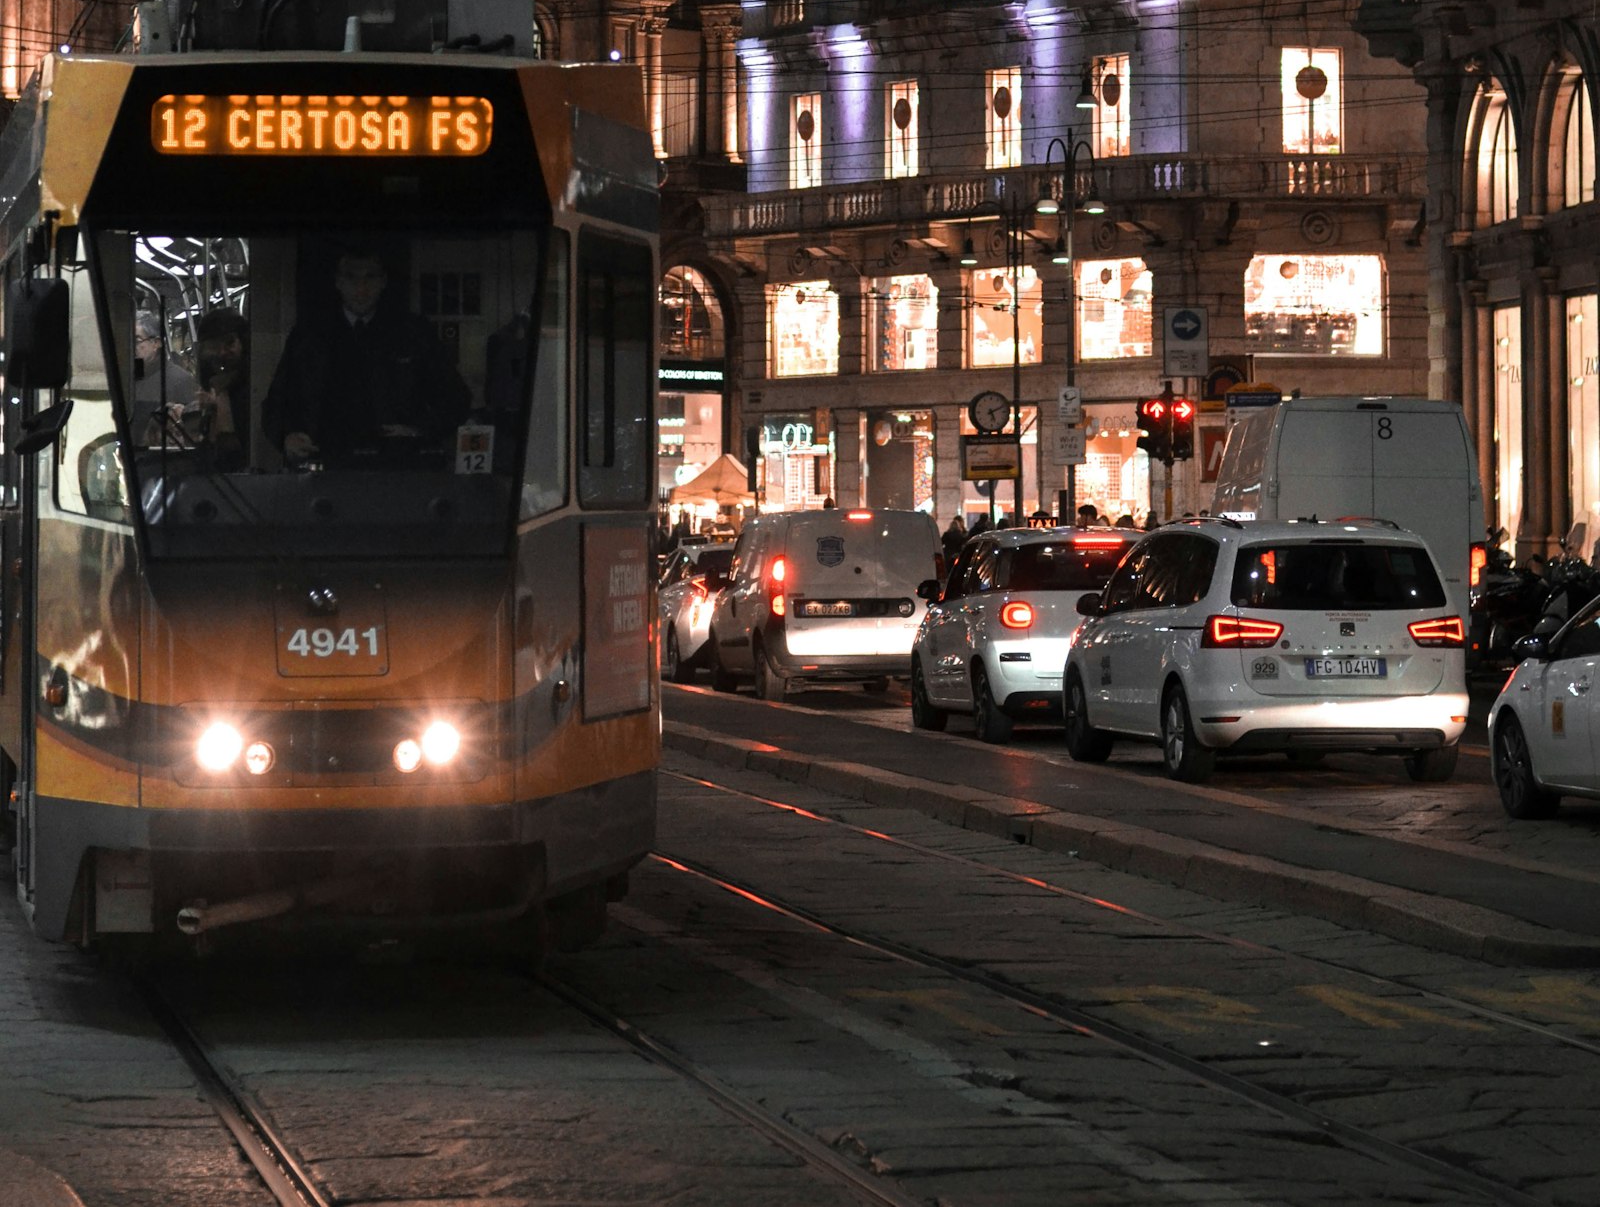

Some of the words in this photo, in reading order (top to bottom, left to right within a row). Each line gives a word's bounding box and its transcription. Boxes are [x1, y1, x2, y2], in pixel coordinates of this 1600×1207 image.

[161, 108, 206, 148] 12
[229, 108, 411, 150] CERTOSA
[430, 110, 479, 151] FS
[1378, 416, 1393, 440] 8
[464, 454, 485, 471] 12
[1028, 518, 1057, 529] TAXI
[807, 605, 818, 615] EX
[287, 627, 378, 657] 4941
[1254, 663, 1276, 674] 929
[1315, 660, 1333, 674] FG
[1339, 660, 1378, 674] 104HV
